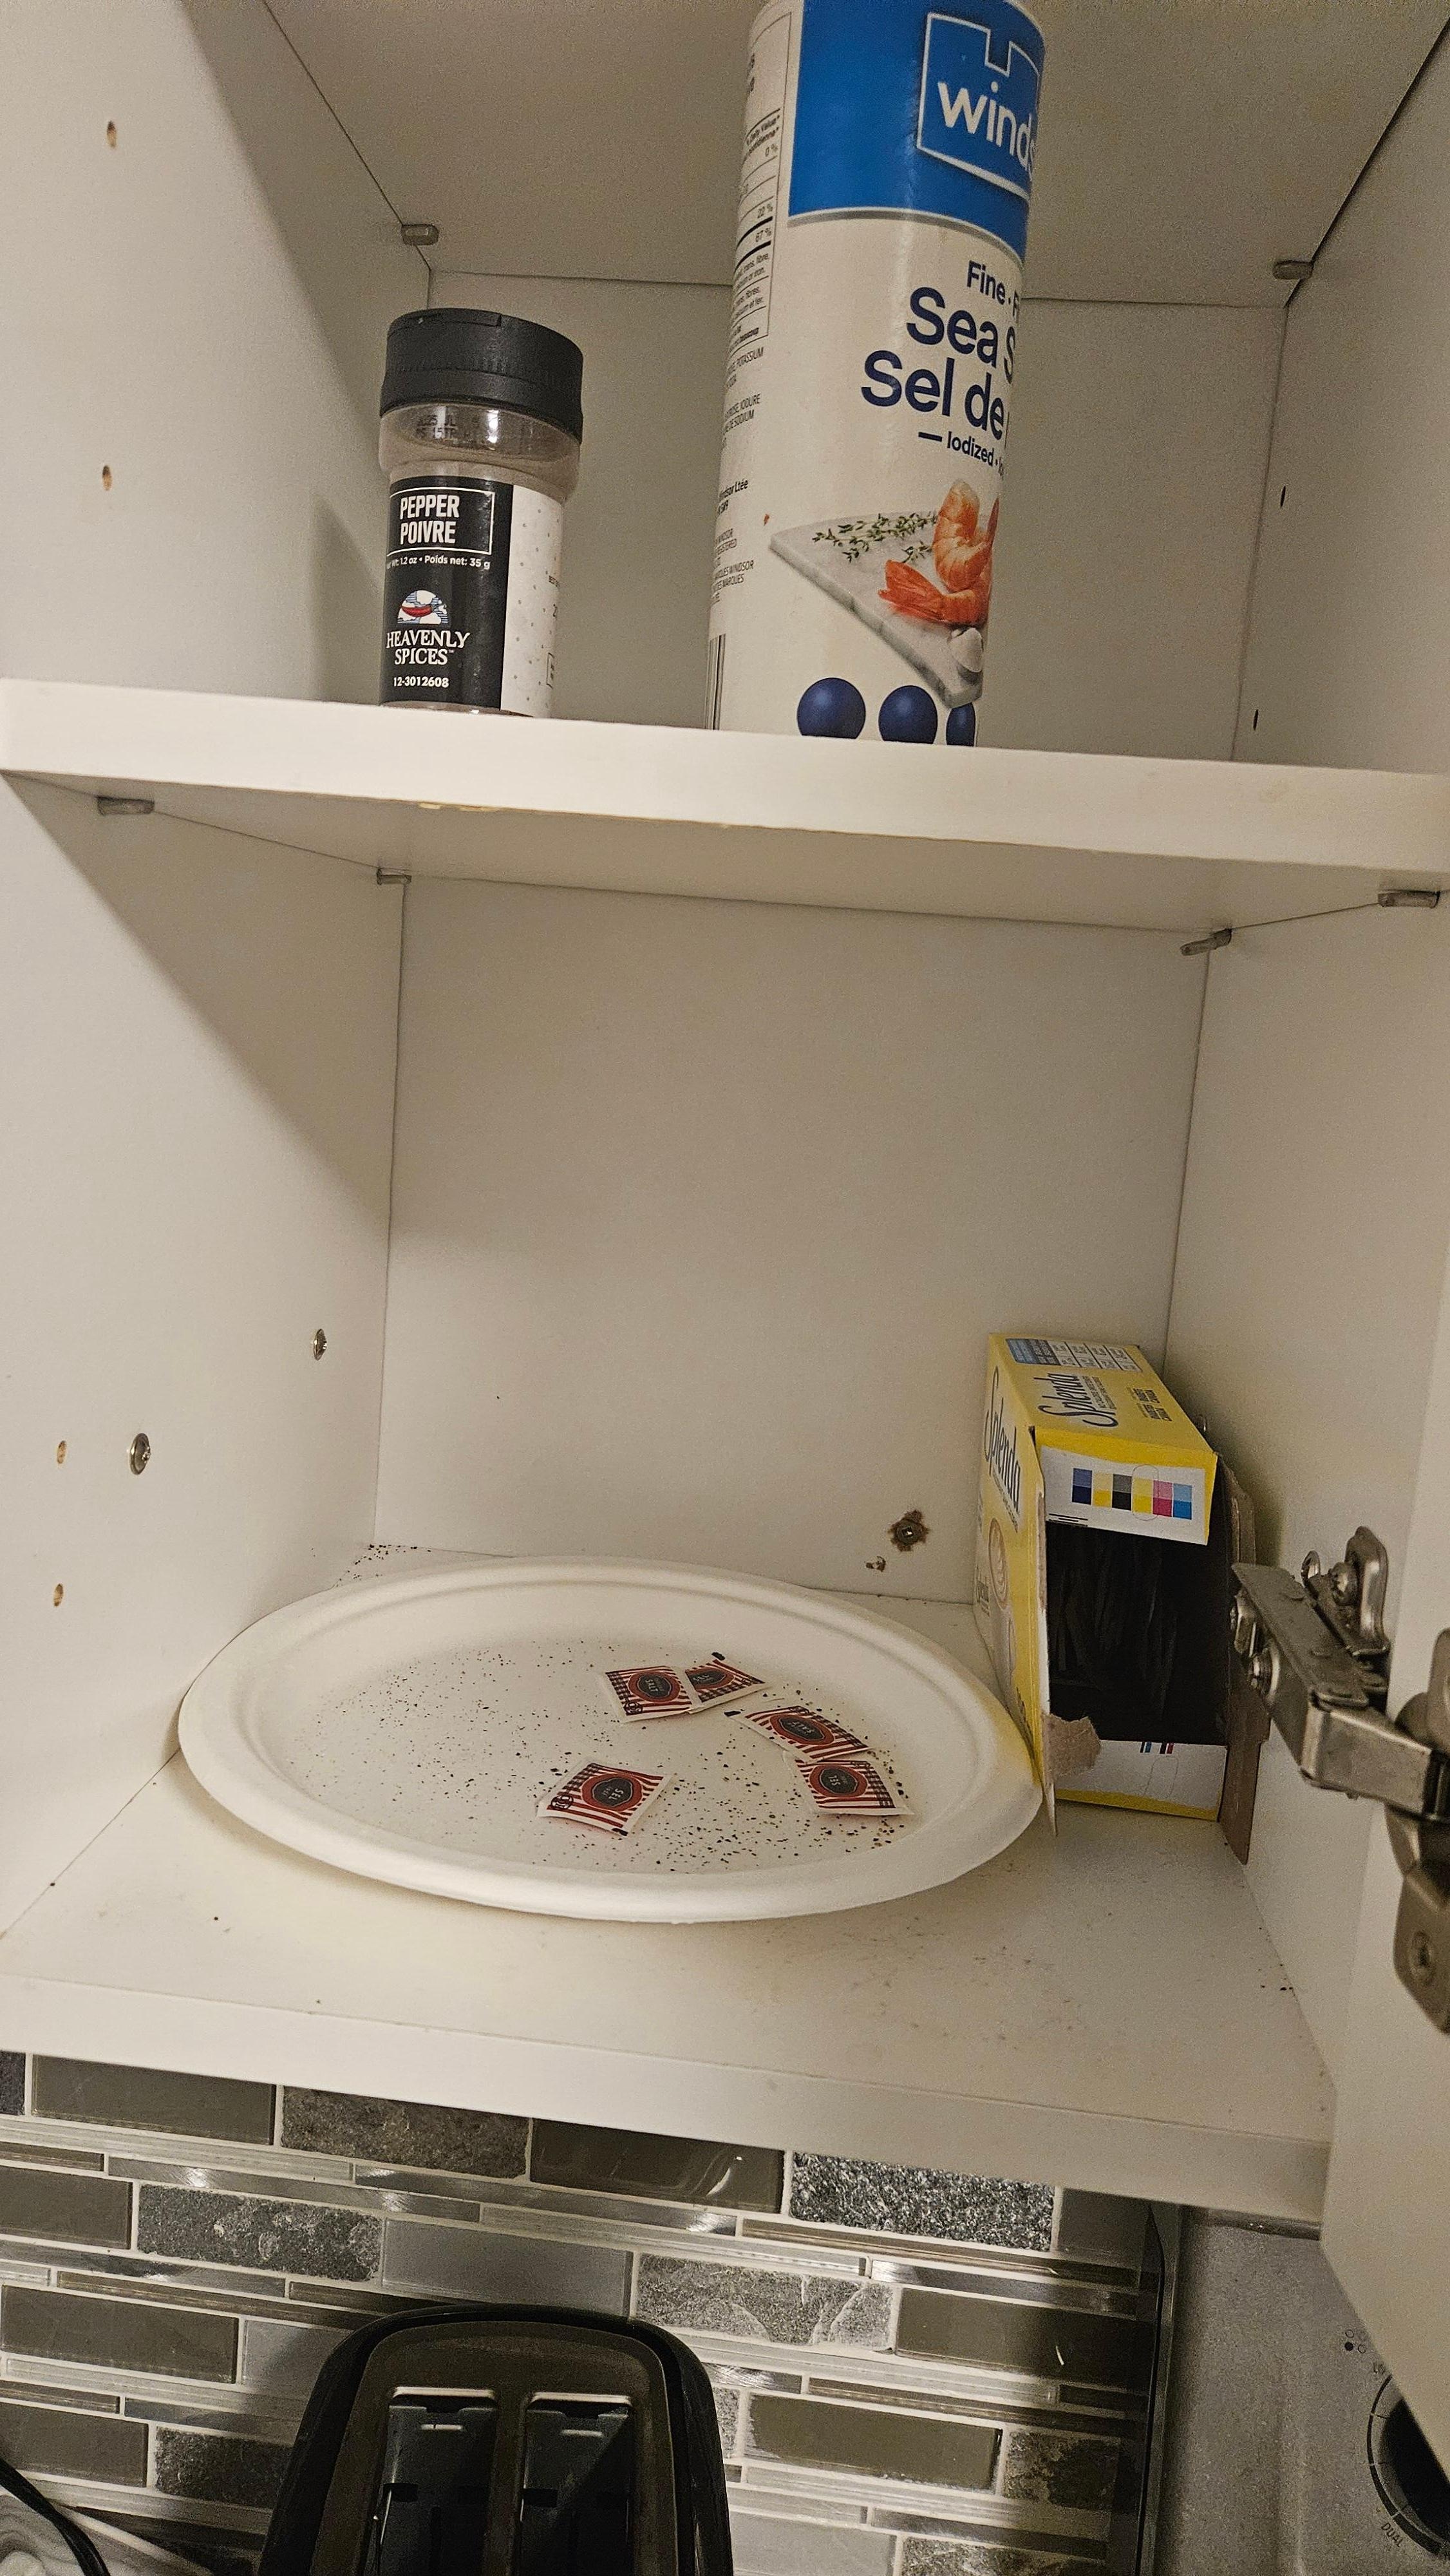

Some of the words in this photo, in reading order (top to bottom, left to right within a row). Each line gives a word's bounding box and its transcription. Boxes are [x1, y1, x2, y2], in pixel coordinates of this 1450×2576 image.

[937, 81, 1033, 178] wind
[966, 260, 1006, 305] Fine
[906, 287, 999, 368] Sea
[861, 350, 955, 417] Sel
[964, 372, 1004, 440] de
[946, 431, 995, 467] Iodized
[734, 478, 749, 493] Ltée
[399, 495, 460, 520] PEPPER
[400, 520, 457, 545] POIVRE
[424, 554, 448, 564] Poids
[449, 557, 468, 566] net:
[469, 558, 482, 567] 35
[484, 561, 491, 570] g
[386, 629, 471, 649] HEAVENLY
[394, 647, 449, 665] SPICES
[393, 676, 449, 688] 12-3012608
[1033, 1372, 1119, 1427] Splenda
[984, 1365, 1021, 1515] Splenda
[608, 1788, 625, 1801] SEL
[1380, 2521, 1404, 2548] DUAL
